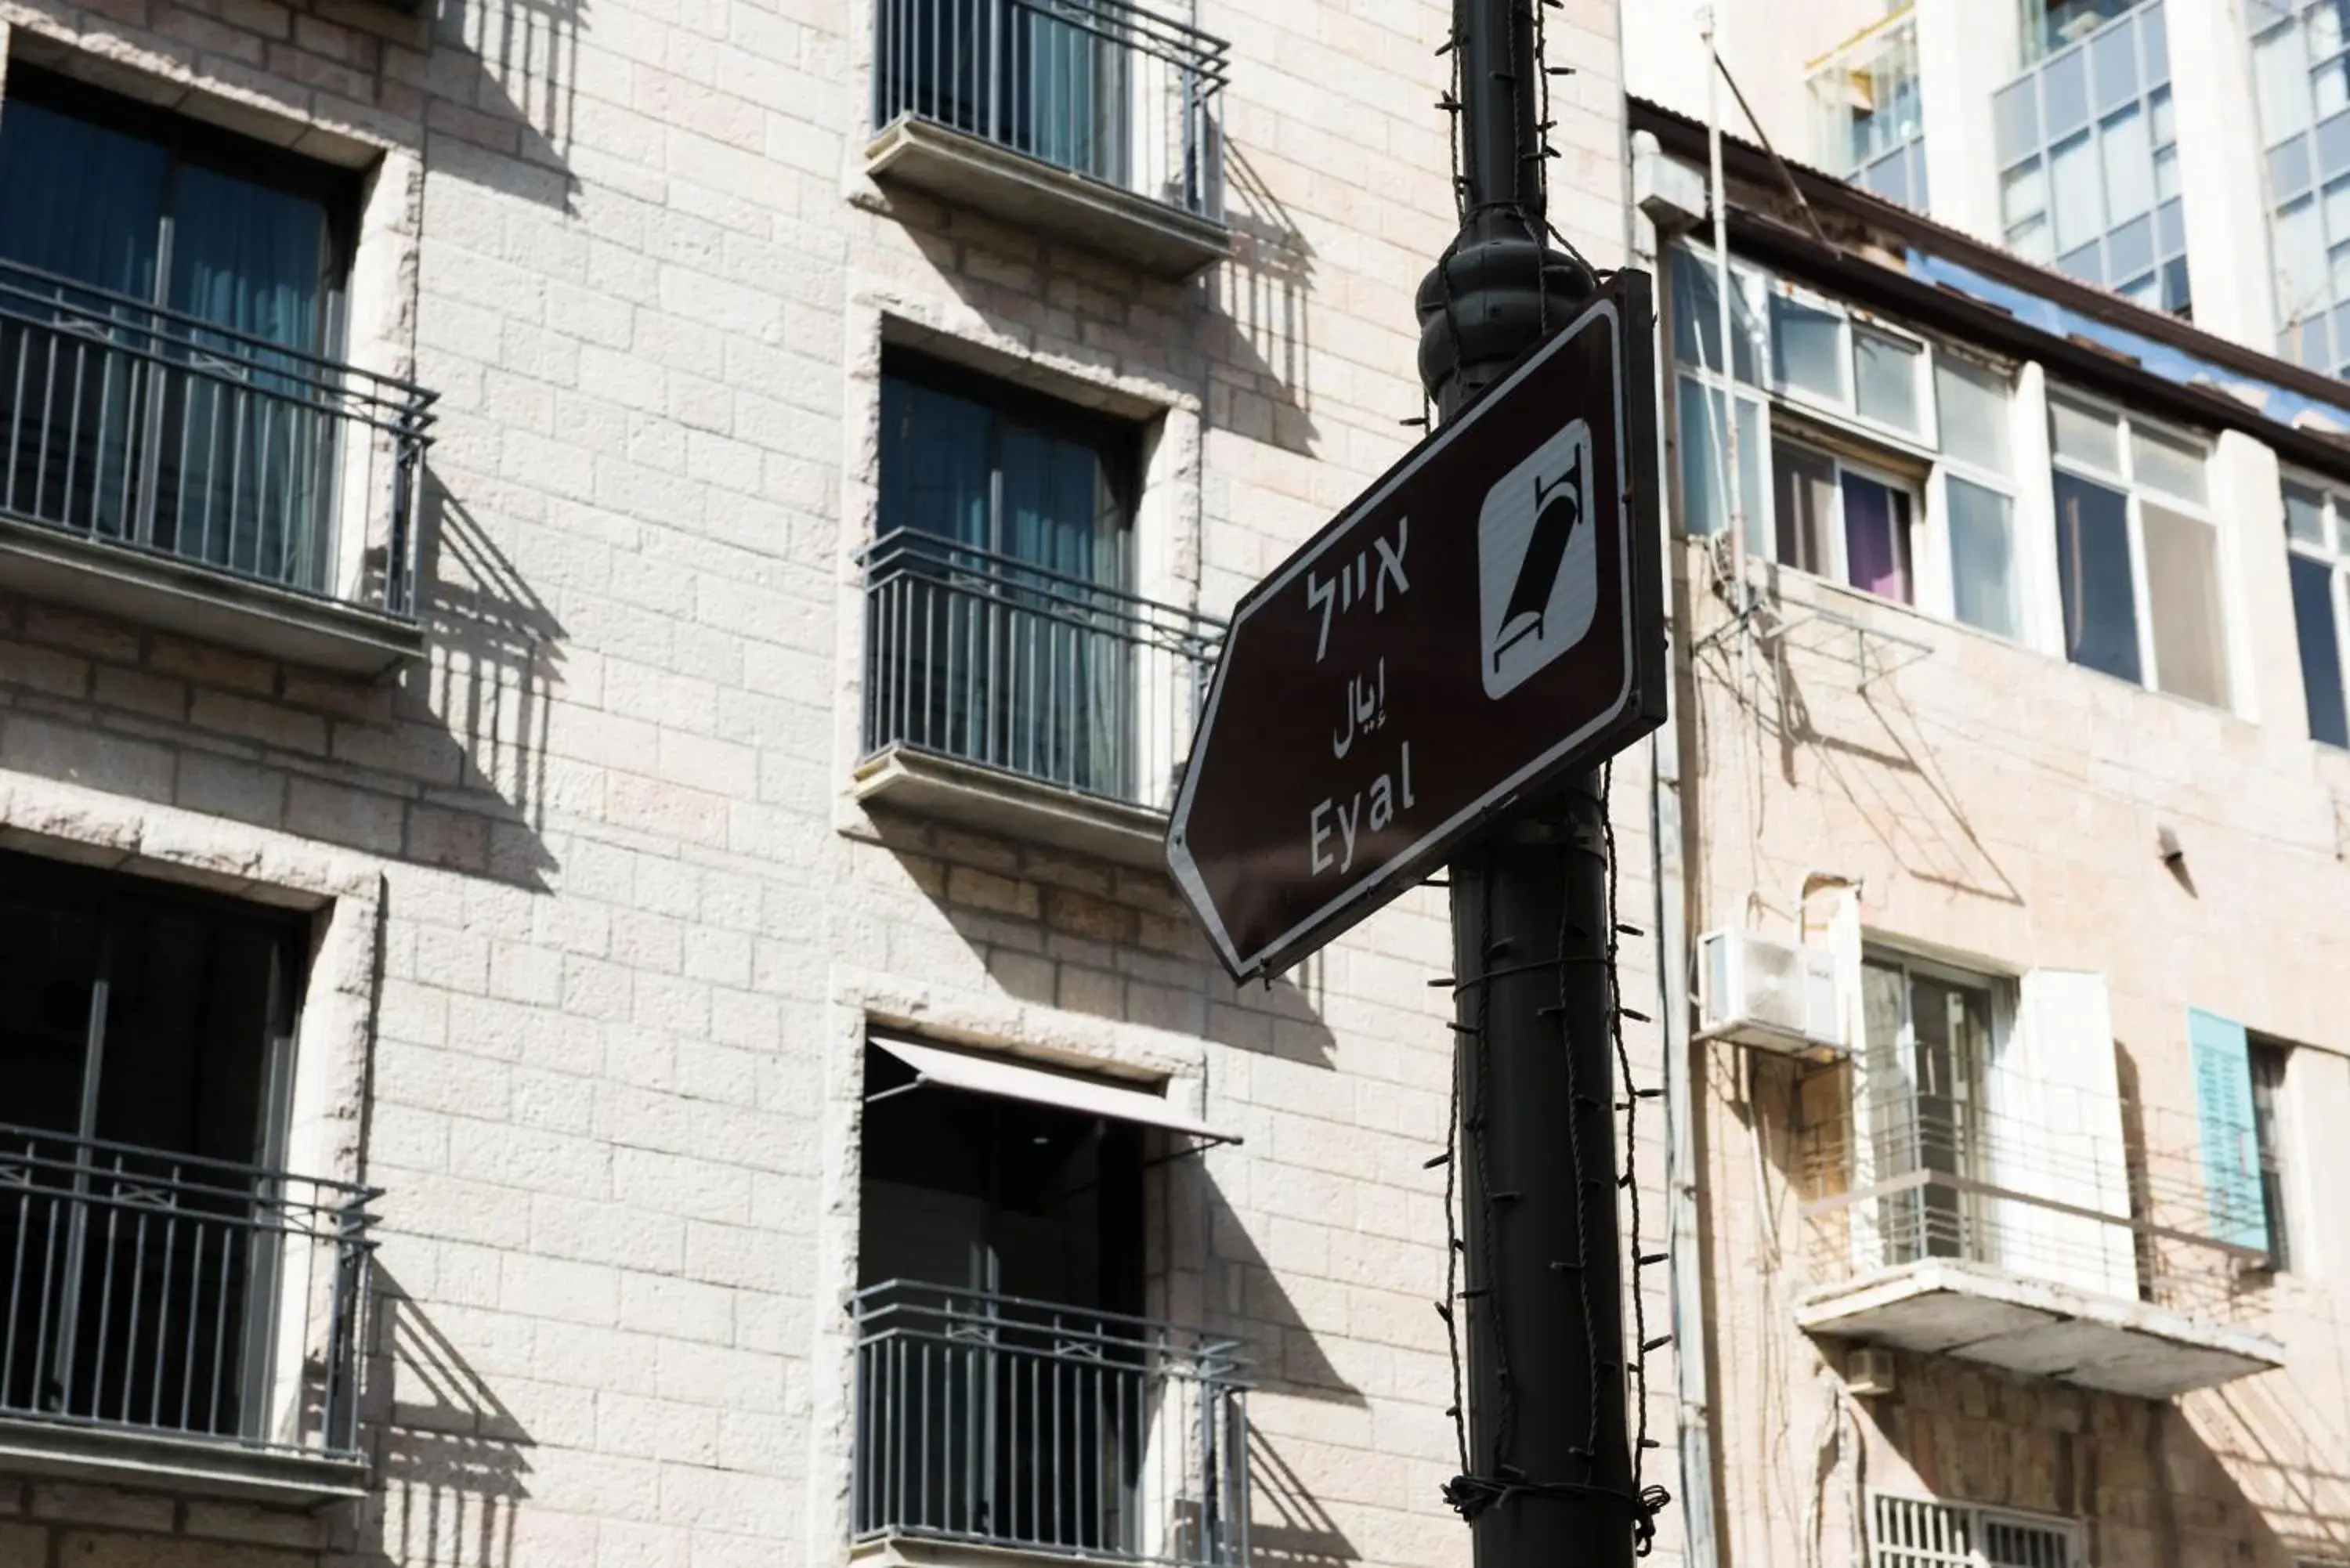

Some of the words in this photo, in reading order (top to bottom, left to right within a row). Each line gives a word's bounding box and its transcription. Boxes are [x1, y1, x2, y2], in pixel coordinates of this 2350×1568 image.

[1307, 515, 1410, 662] אייל
[1333, 656, 1386, 760] إيال
[1311, 740, 1415, 876] Eyal
